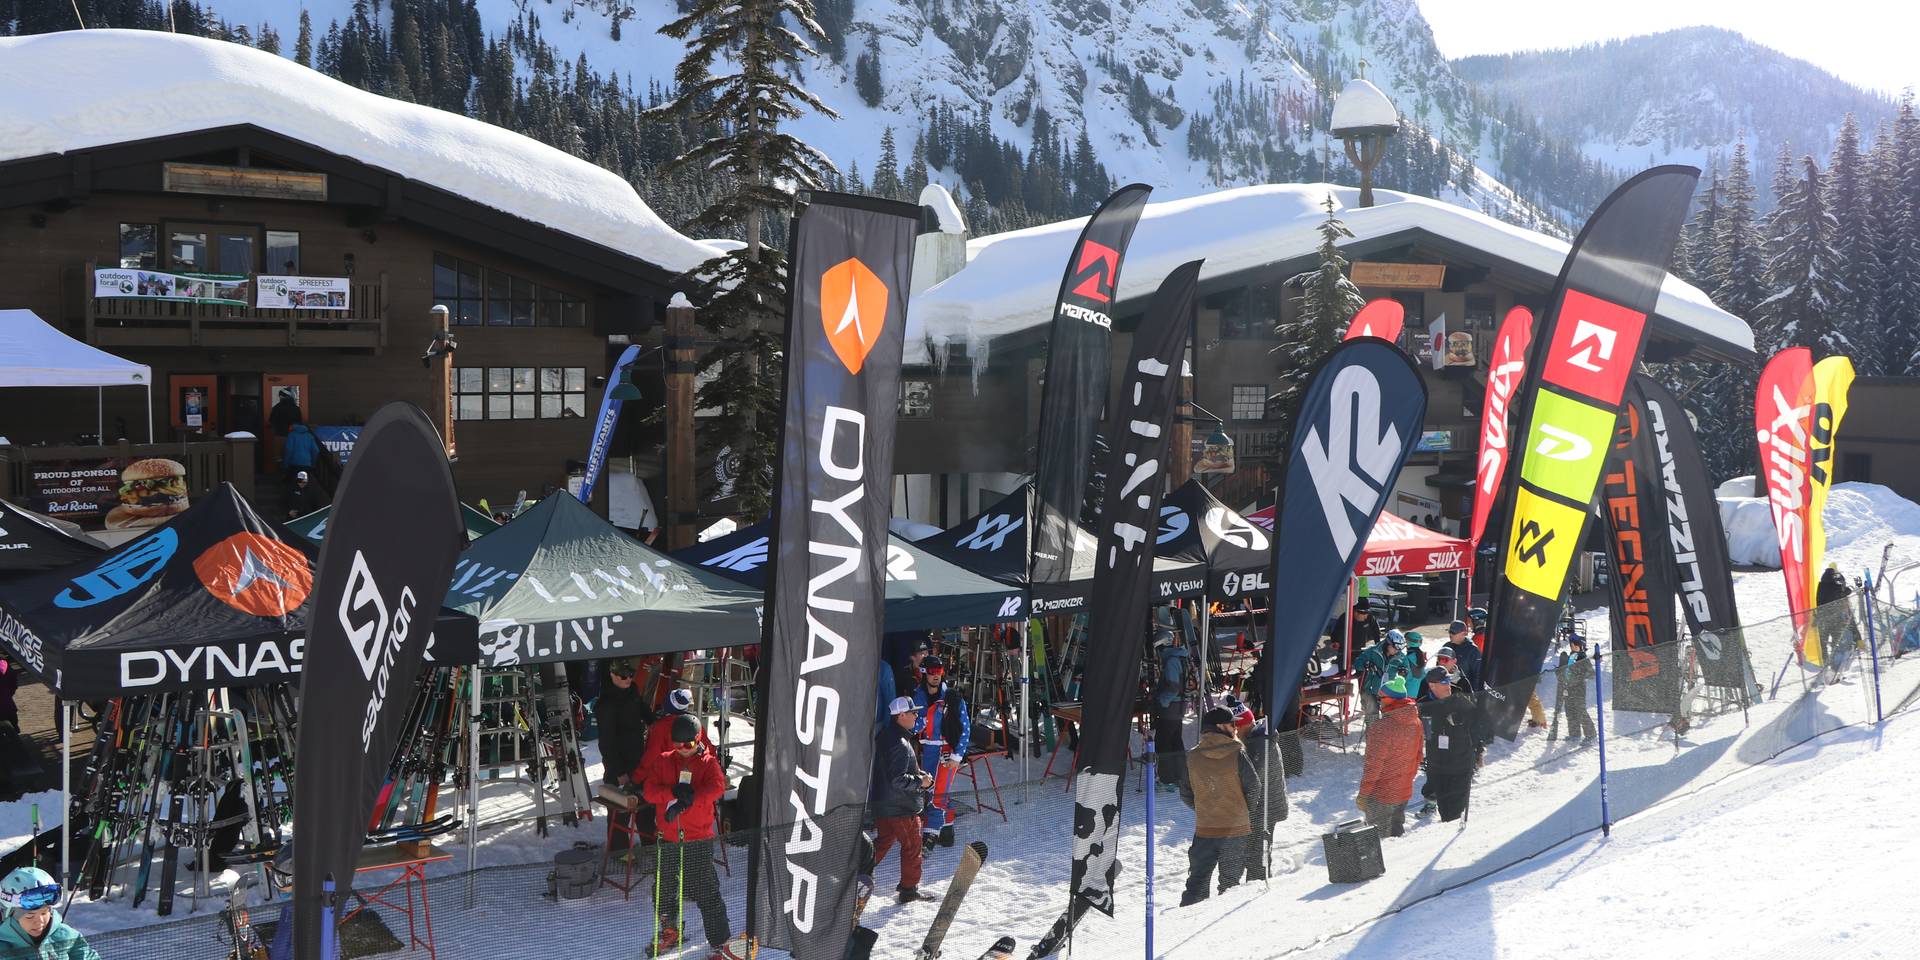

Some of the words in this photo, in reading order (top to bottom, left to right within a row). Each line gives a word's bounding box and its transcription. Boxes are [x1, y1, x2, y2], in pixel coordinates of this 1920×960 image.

[34, 472, 70, 480] PROUD
[71, 469, 118, 478] SPONSOR
[48, 501, 68, 512] Red
[69, 500, 98, 511] Robin
[1301, 364, 1402, 564] K2
[997, 596, 1022, 617] K2
[1604, 459, 1660, 682] TECNICA
[783, 405, 867, 935] DYNASTAR
